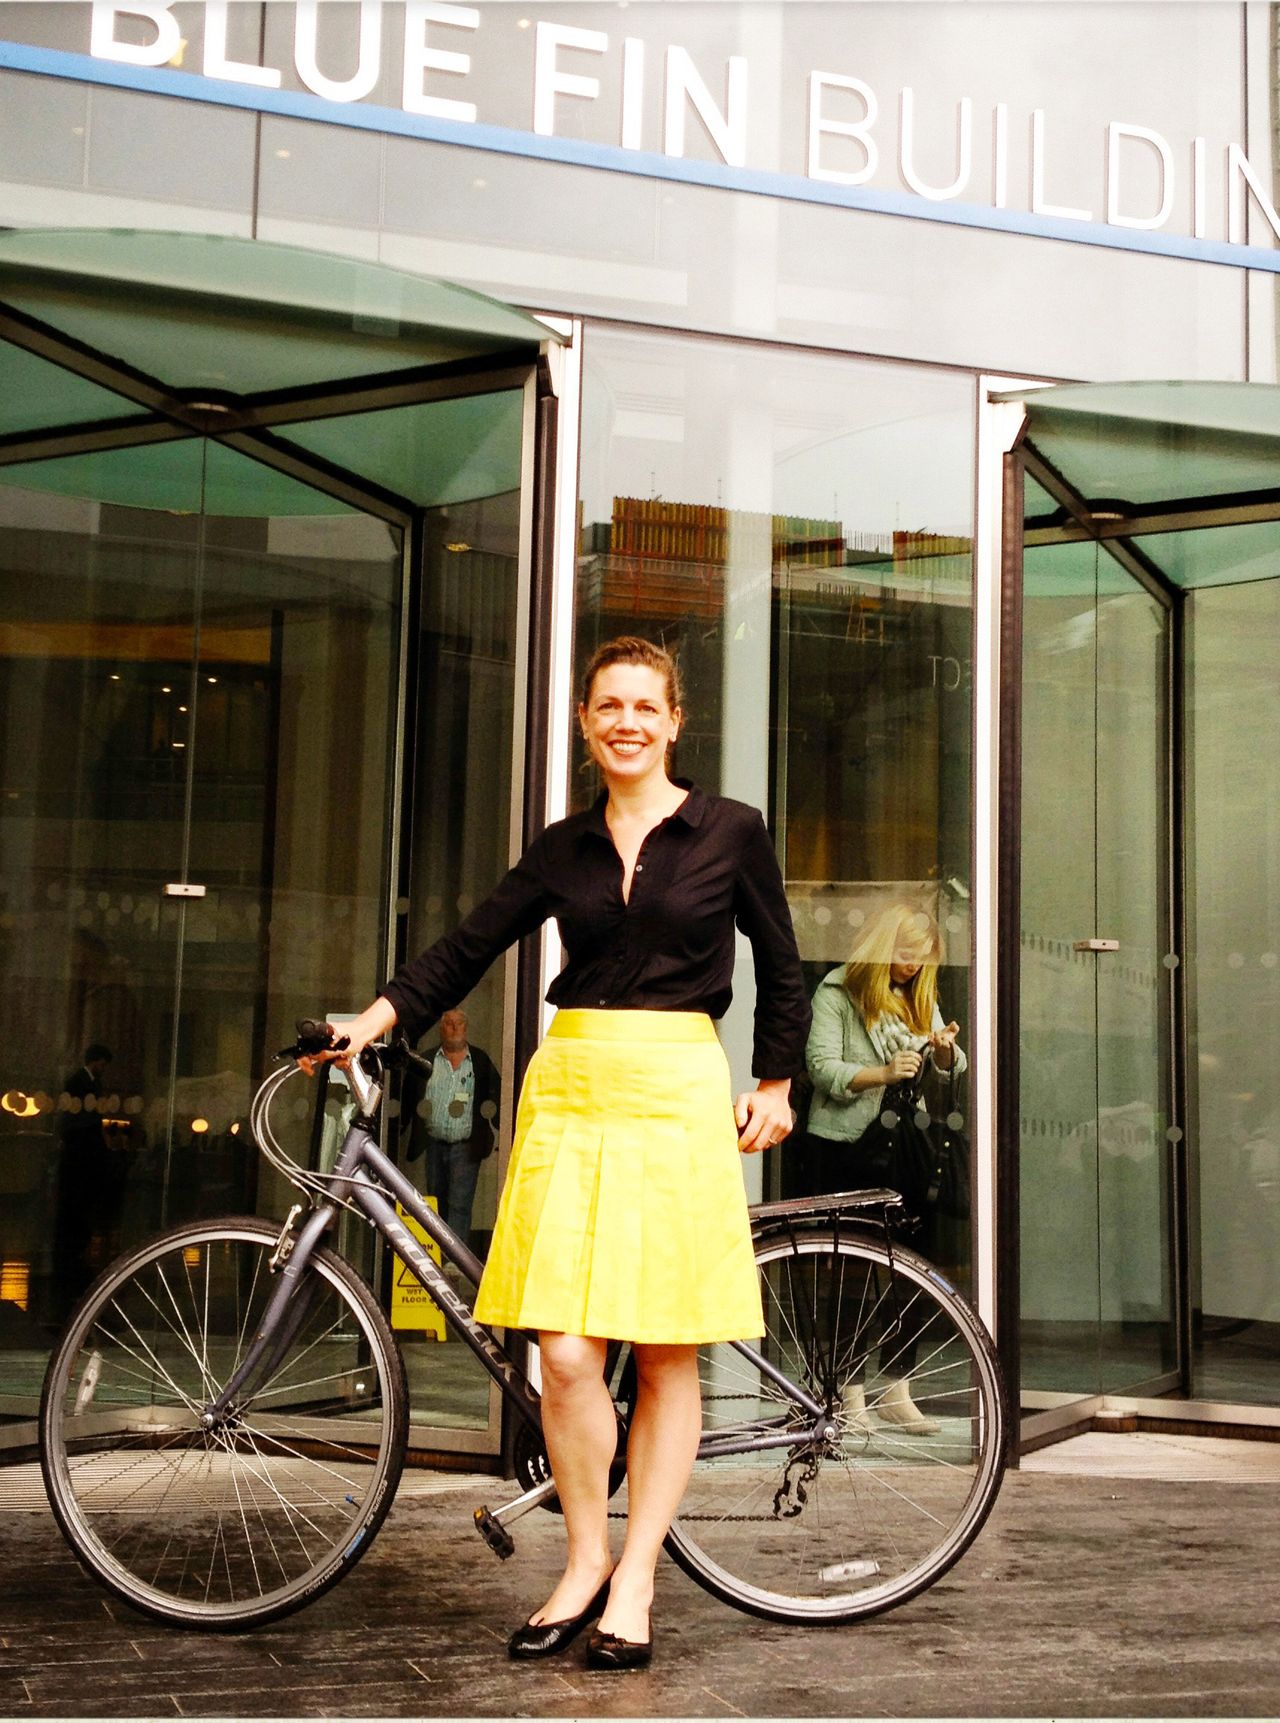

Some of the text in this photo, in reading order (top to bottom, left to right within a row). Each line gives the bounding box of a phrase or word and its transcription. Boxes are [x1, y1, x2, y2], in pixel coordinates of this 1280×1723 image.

[90, 1, 1280, 244] BLUE FIN BUILDIN
